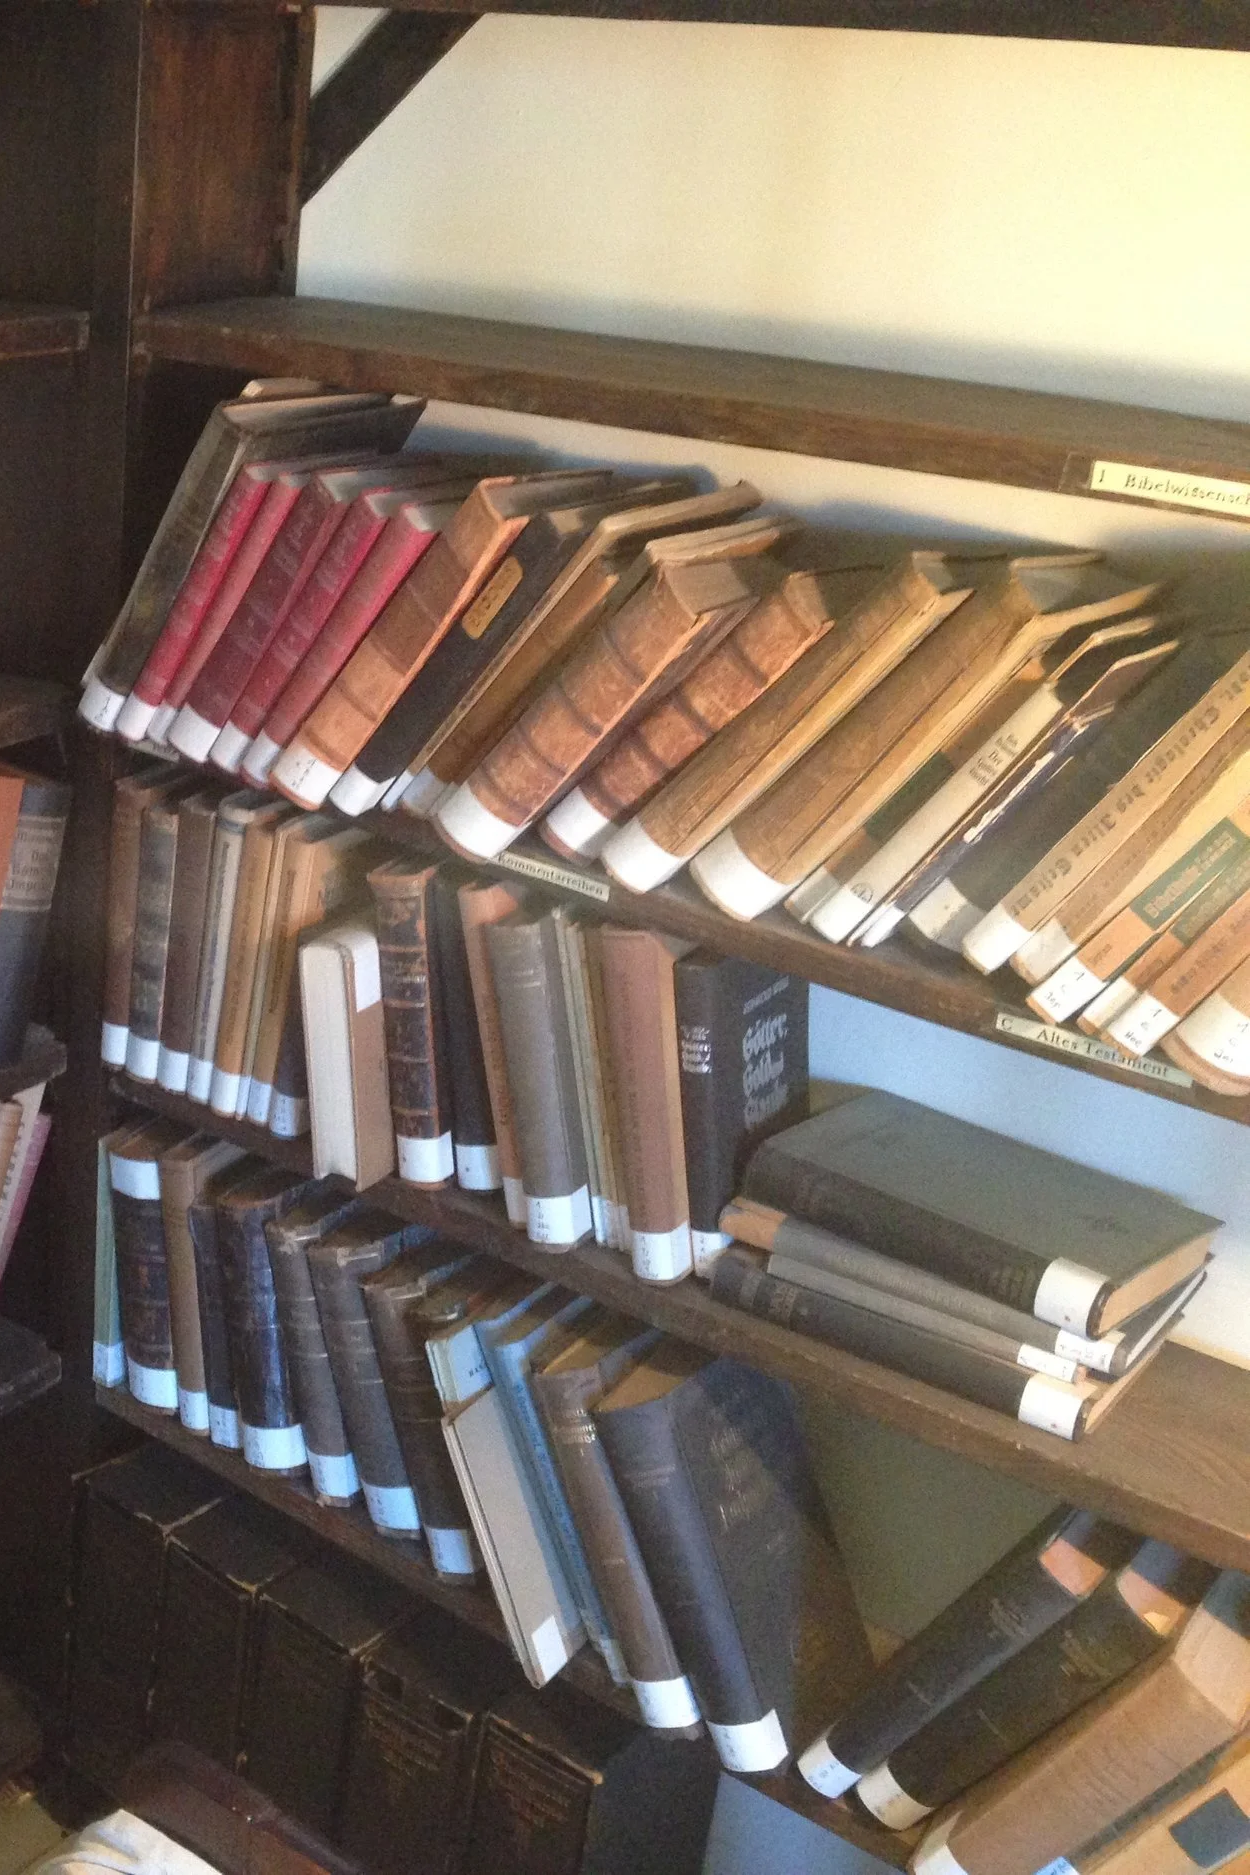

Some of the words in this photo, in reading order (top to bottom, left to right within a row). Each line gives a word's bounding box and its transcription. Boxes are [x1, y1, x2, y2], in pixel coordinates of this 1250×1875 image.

[1001, 1017, 1014, 1031] C
[1037, 1028, 1079, 1051] Altes
[1084, 1039, 1170, 1078] Testament
